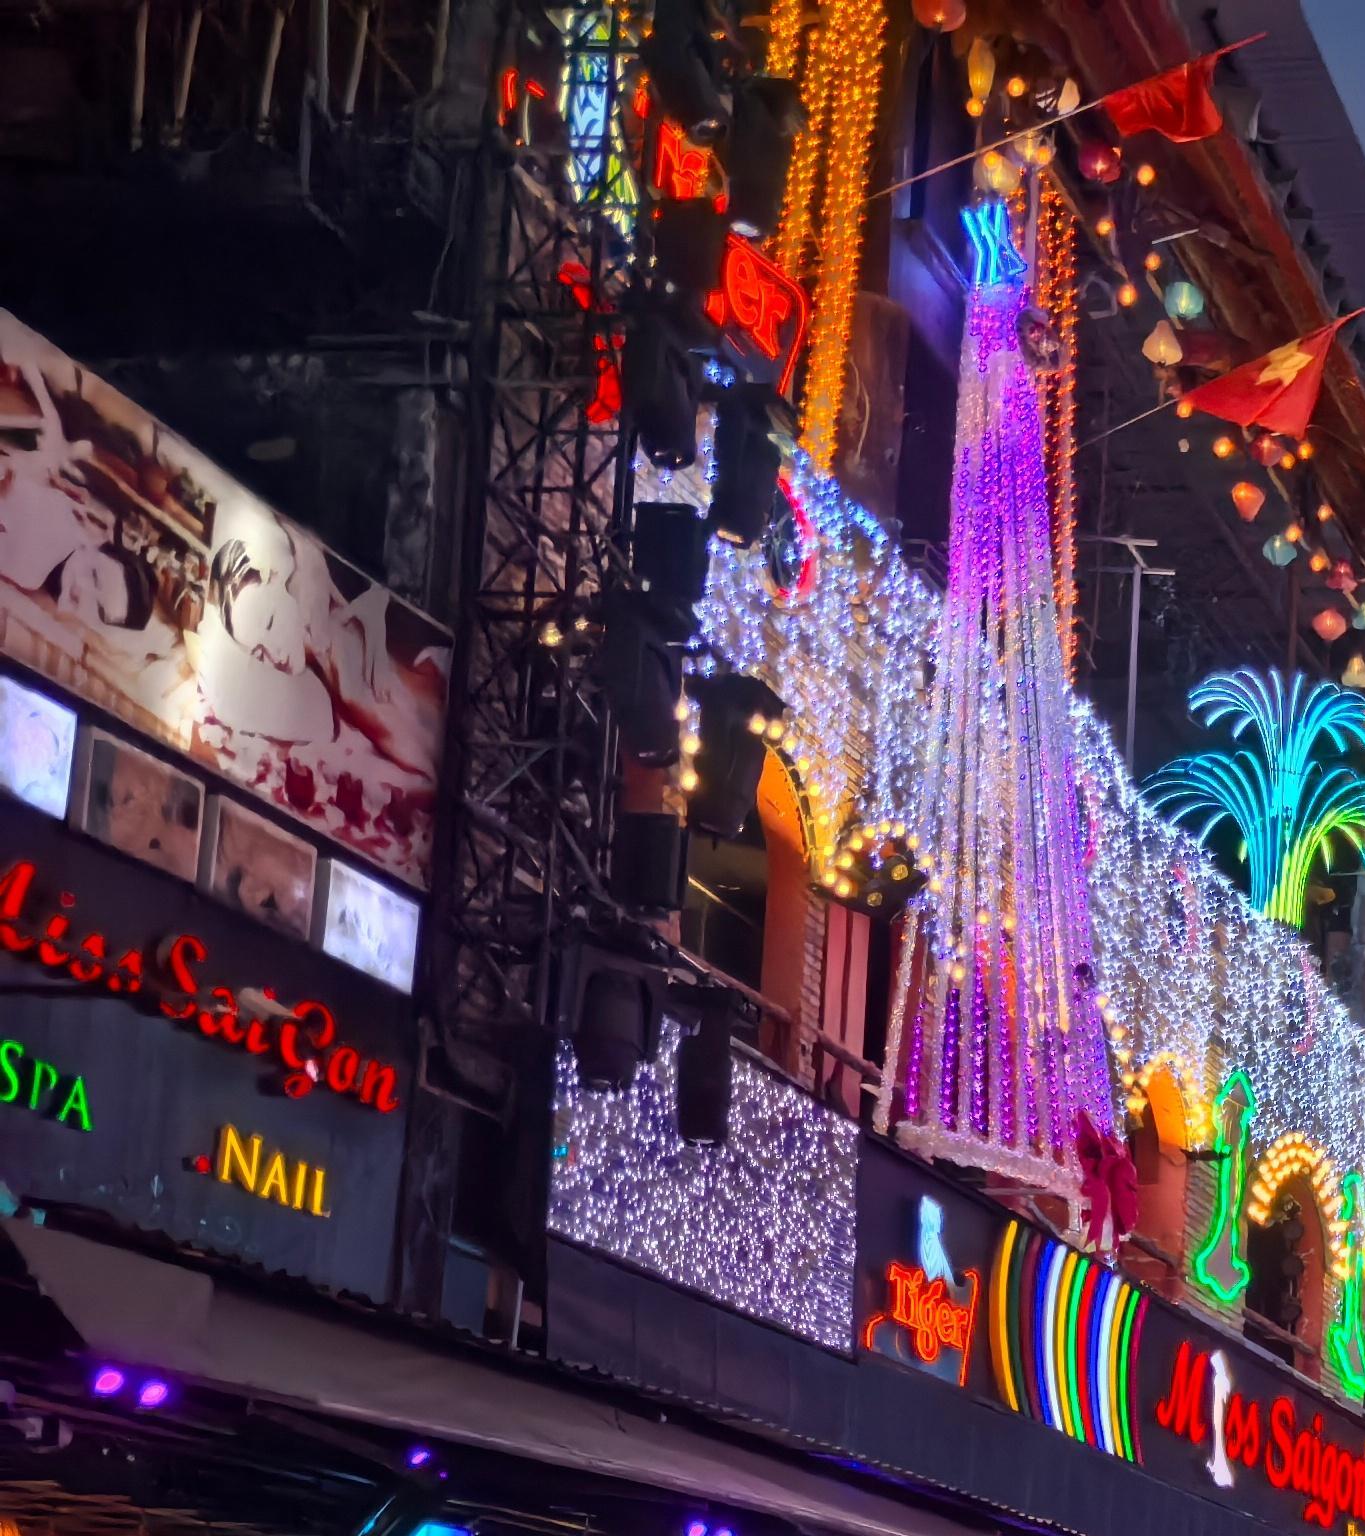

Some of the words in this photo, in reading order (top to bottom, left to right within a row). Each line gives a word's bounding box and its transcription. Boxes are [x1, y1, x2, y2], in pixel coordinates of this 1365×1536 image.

[0, 1039, 93, 1132] SPA
[218, 1123, 331, 1217] NAIL
[889, 1262, 970, 1362] Tiger
